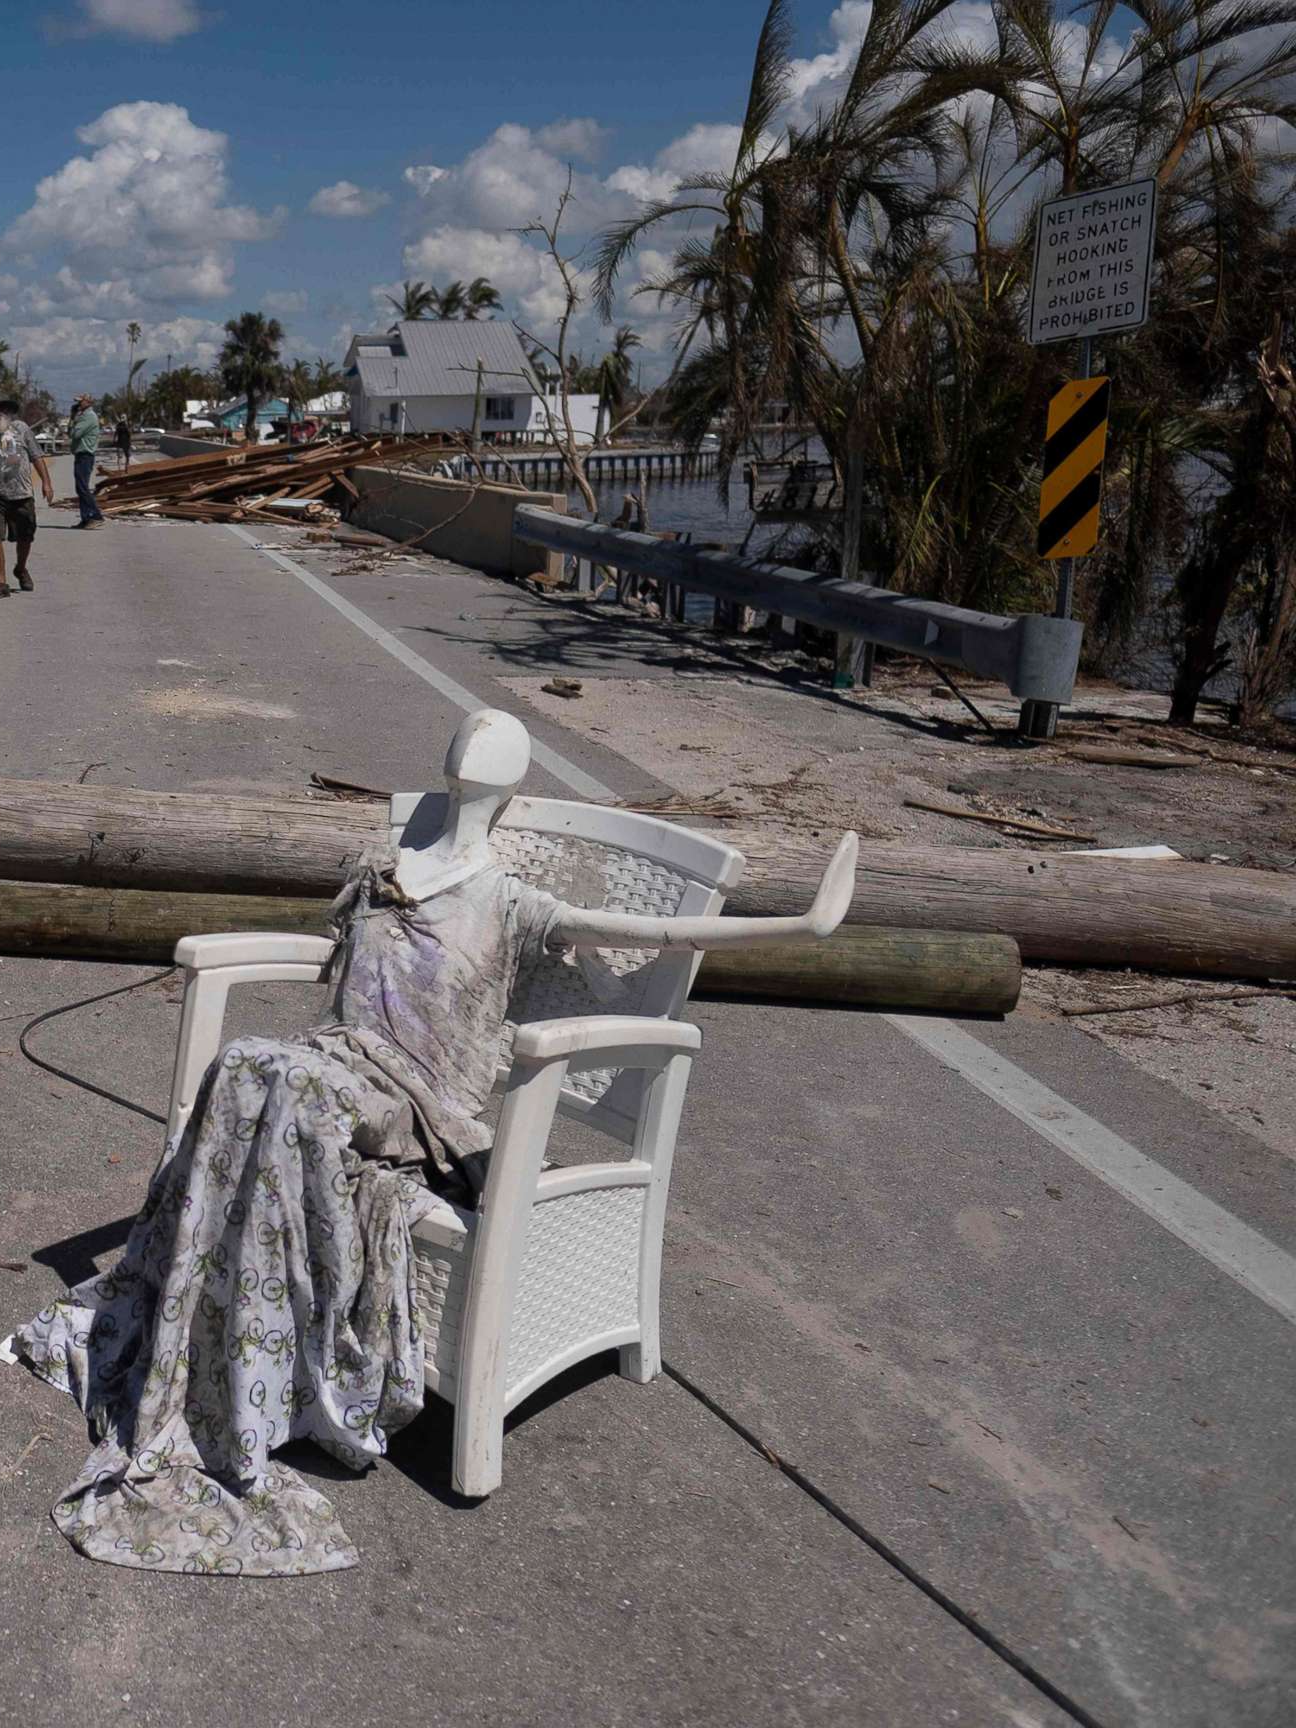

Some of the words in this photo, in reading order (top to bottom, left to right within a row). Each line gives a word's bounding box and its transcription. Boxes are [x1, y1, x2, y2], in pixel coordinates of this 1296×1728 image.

[1046, 208, 1076, 227] NET
[1081, 192, 1148, 219] FISHING
[1048, 231, 1070, 247] OR
[1076, 214, 1142, 241] SNATCH
[1056, 238, 1129, 266] HOOKING
[1047, 269, 1091, 288] FROM
[1099, 258, 1134, 279] THIS
[1048, 285, 1106, 309] BRIDGE
[1113, 280, 1129, 296] IS
[1039, 301, 1135, 330] PROHIBITED
